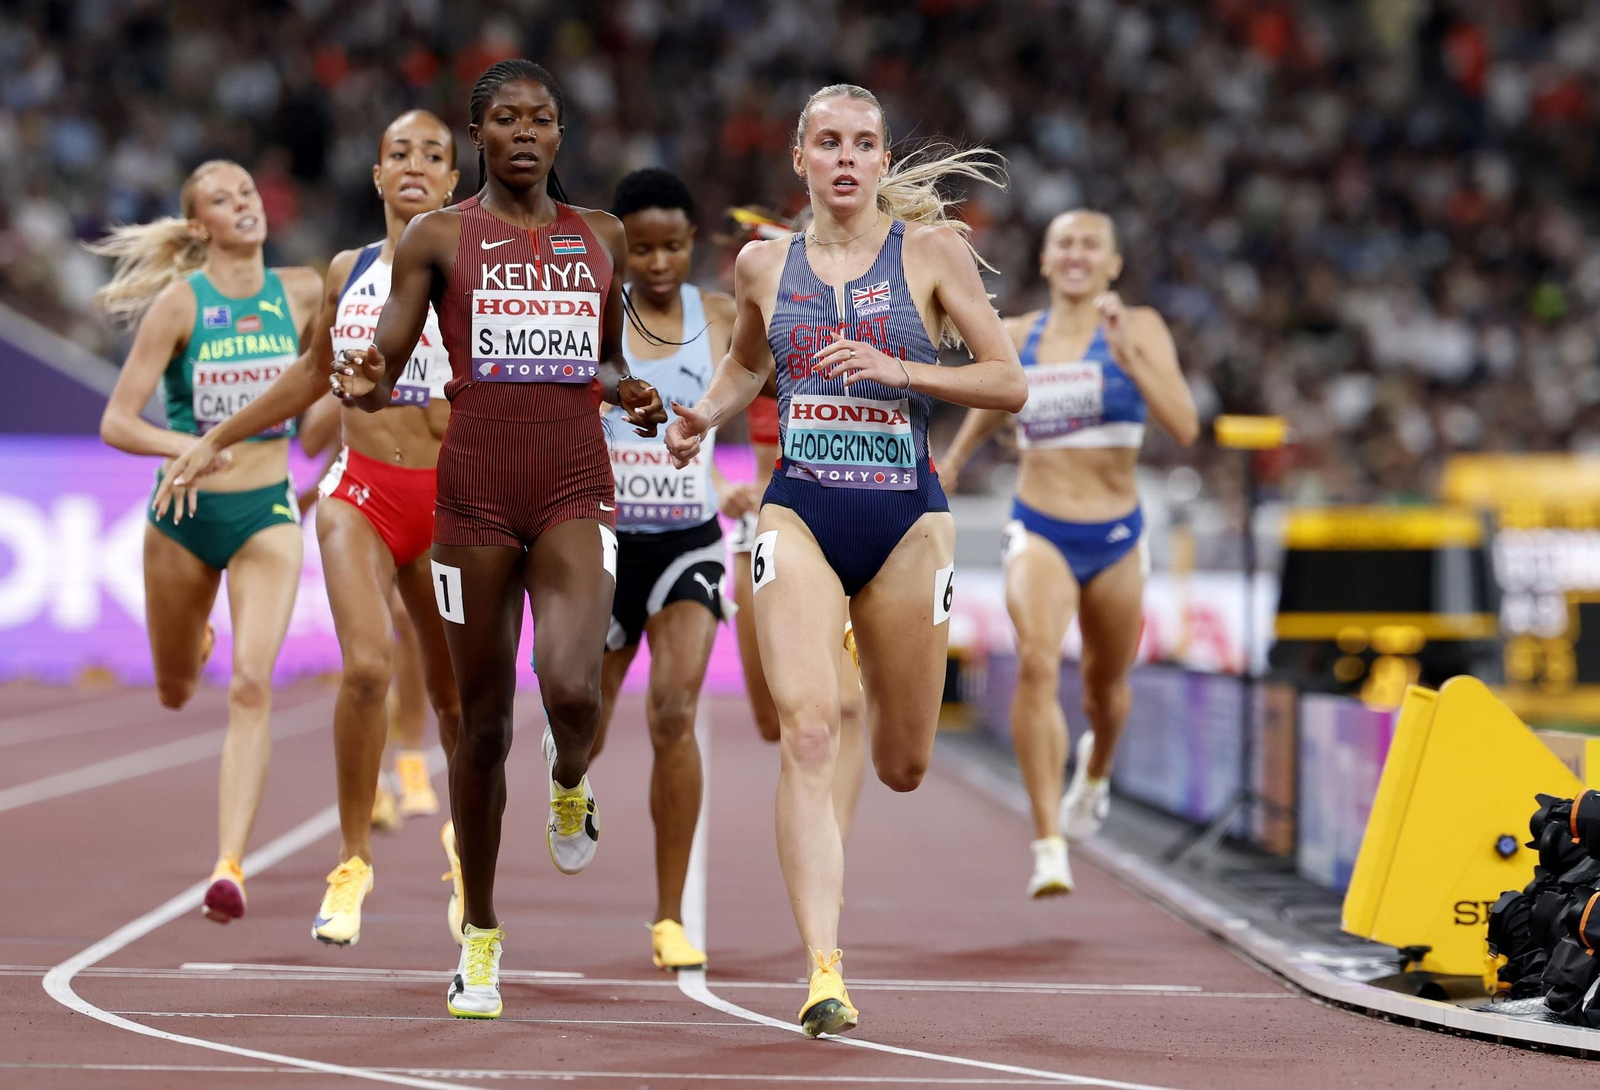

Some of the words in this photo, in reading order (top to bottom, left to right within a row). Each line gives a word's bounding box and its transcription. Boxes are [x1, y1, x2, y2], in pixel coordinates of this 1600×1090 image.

[482, 261, 596, 291] KENYA
[475, 298, 597, 318] HONDA
[857, 304, 891, 317] Novuna
[198, 333, 297, 362] AUSTRALIA
[478, 328, 499, 356] S.
[505, 328, 593, 358] MORAA
[791, 403, 908, 426] HONDA
[790, 432, 912, 464] HODGKINSON
[753, 542, 765, 584] 6
[439, 573, 451, 614] 1
[943, 571, 954, 613] 6
